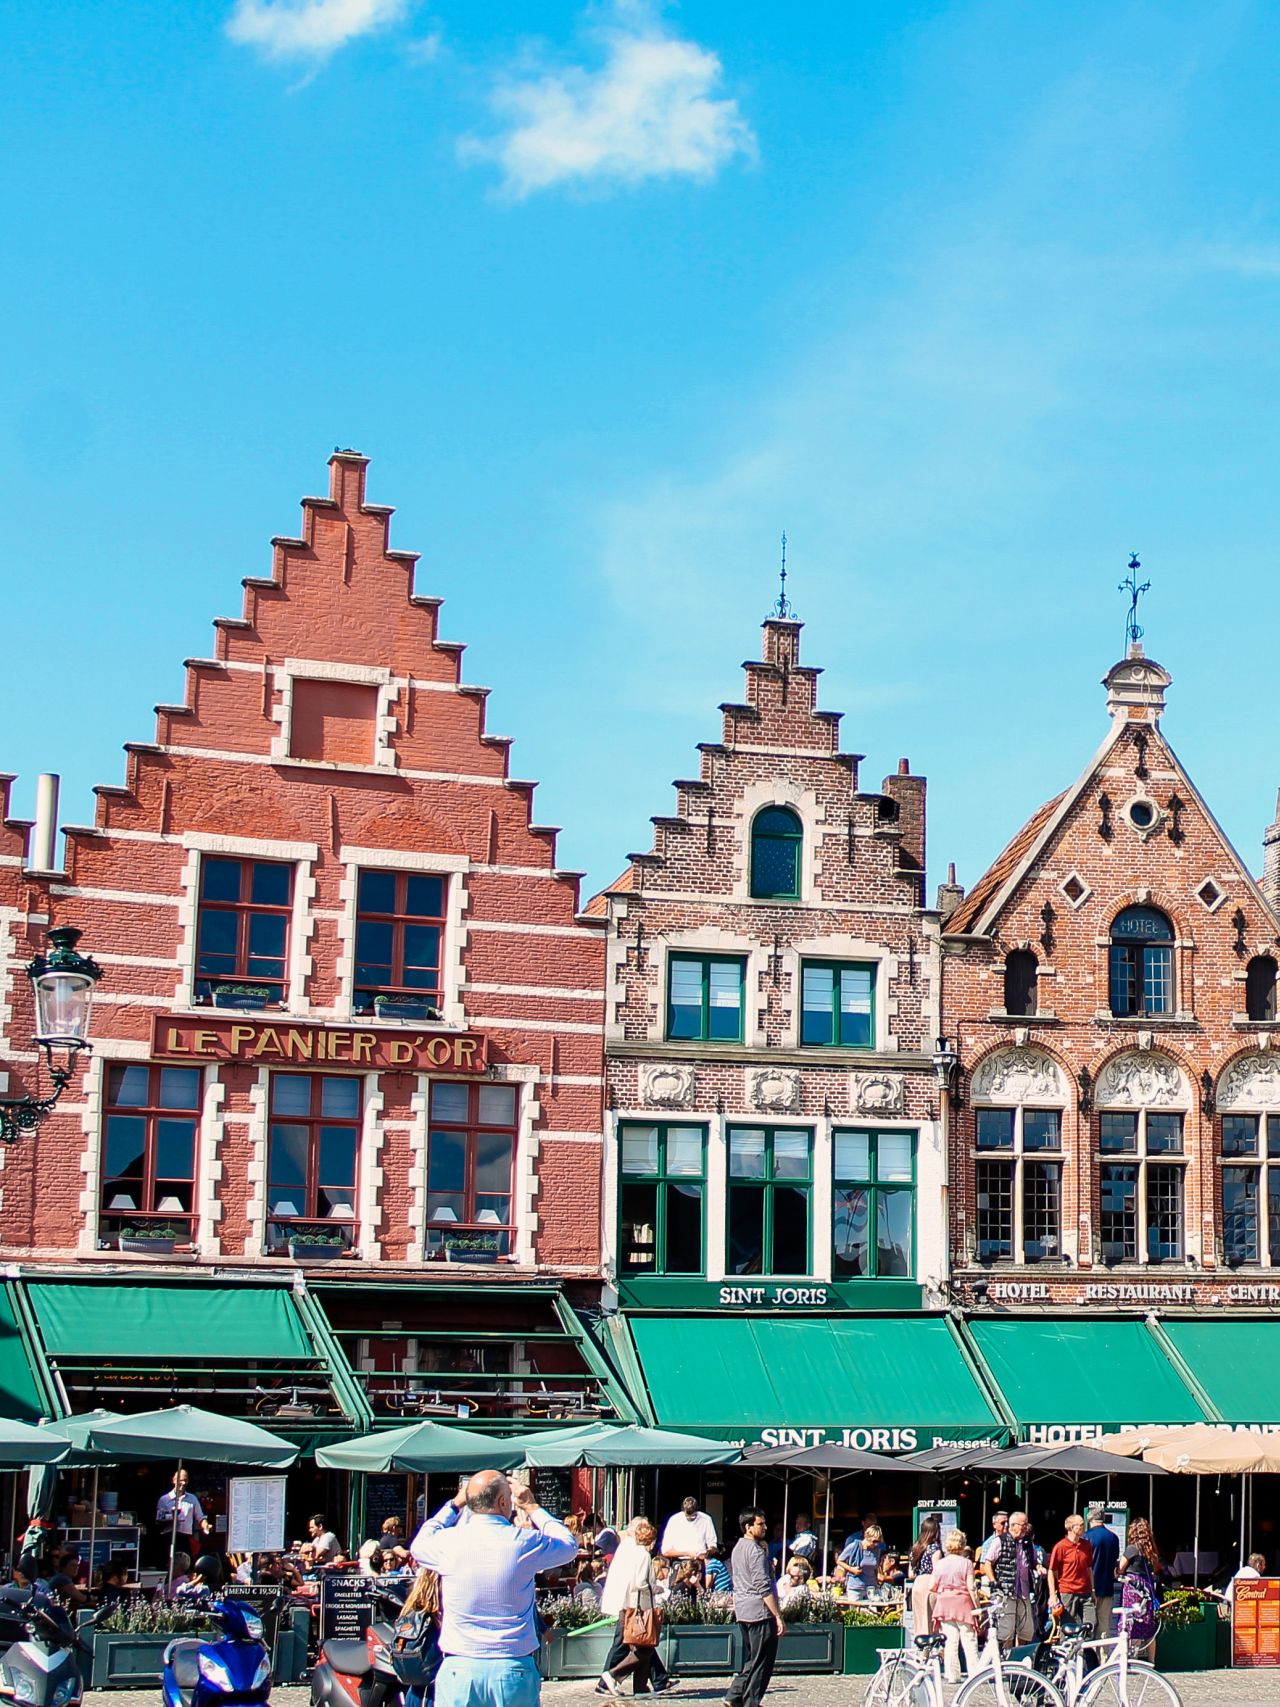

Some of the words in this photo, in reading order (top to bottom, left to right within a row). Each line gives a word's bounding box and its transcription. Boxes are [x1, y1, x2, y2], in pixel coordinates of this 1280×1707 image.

[1121, 919, 1159, 934] HOTEL
[167, 1027, 216, 1053] LE
[230, 1024, 377, 1062] PANIER
[389, 1035, 478, 1067] D'OR
[719, 1287, 766, 1304] SINT
[771, 1288, 827, 1305] JORIS
[995, 1283, 1050, 1299] HOTEL
[1085, 1284, 1194, 1300] RESTAURANT
[760, 1428, 827, 1449] SINT
[835, 1428, 918, 1451] JORIS
[932, 1436, 999, 1450] Brasserie
[917, 1500, 935, 1508] SINT
[936, 1499, 957, 1508] JORIS
[1088, 1501, 1105, 1509] SINT
[1106, 1501, 1128, 1510] JORIS
[331, 1579, 366, 1588] SNACKS
[228, 1587, 251, 1595] MENU
[259, 1587, 278, 1596] 19,50
